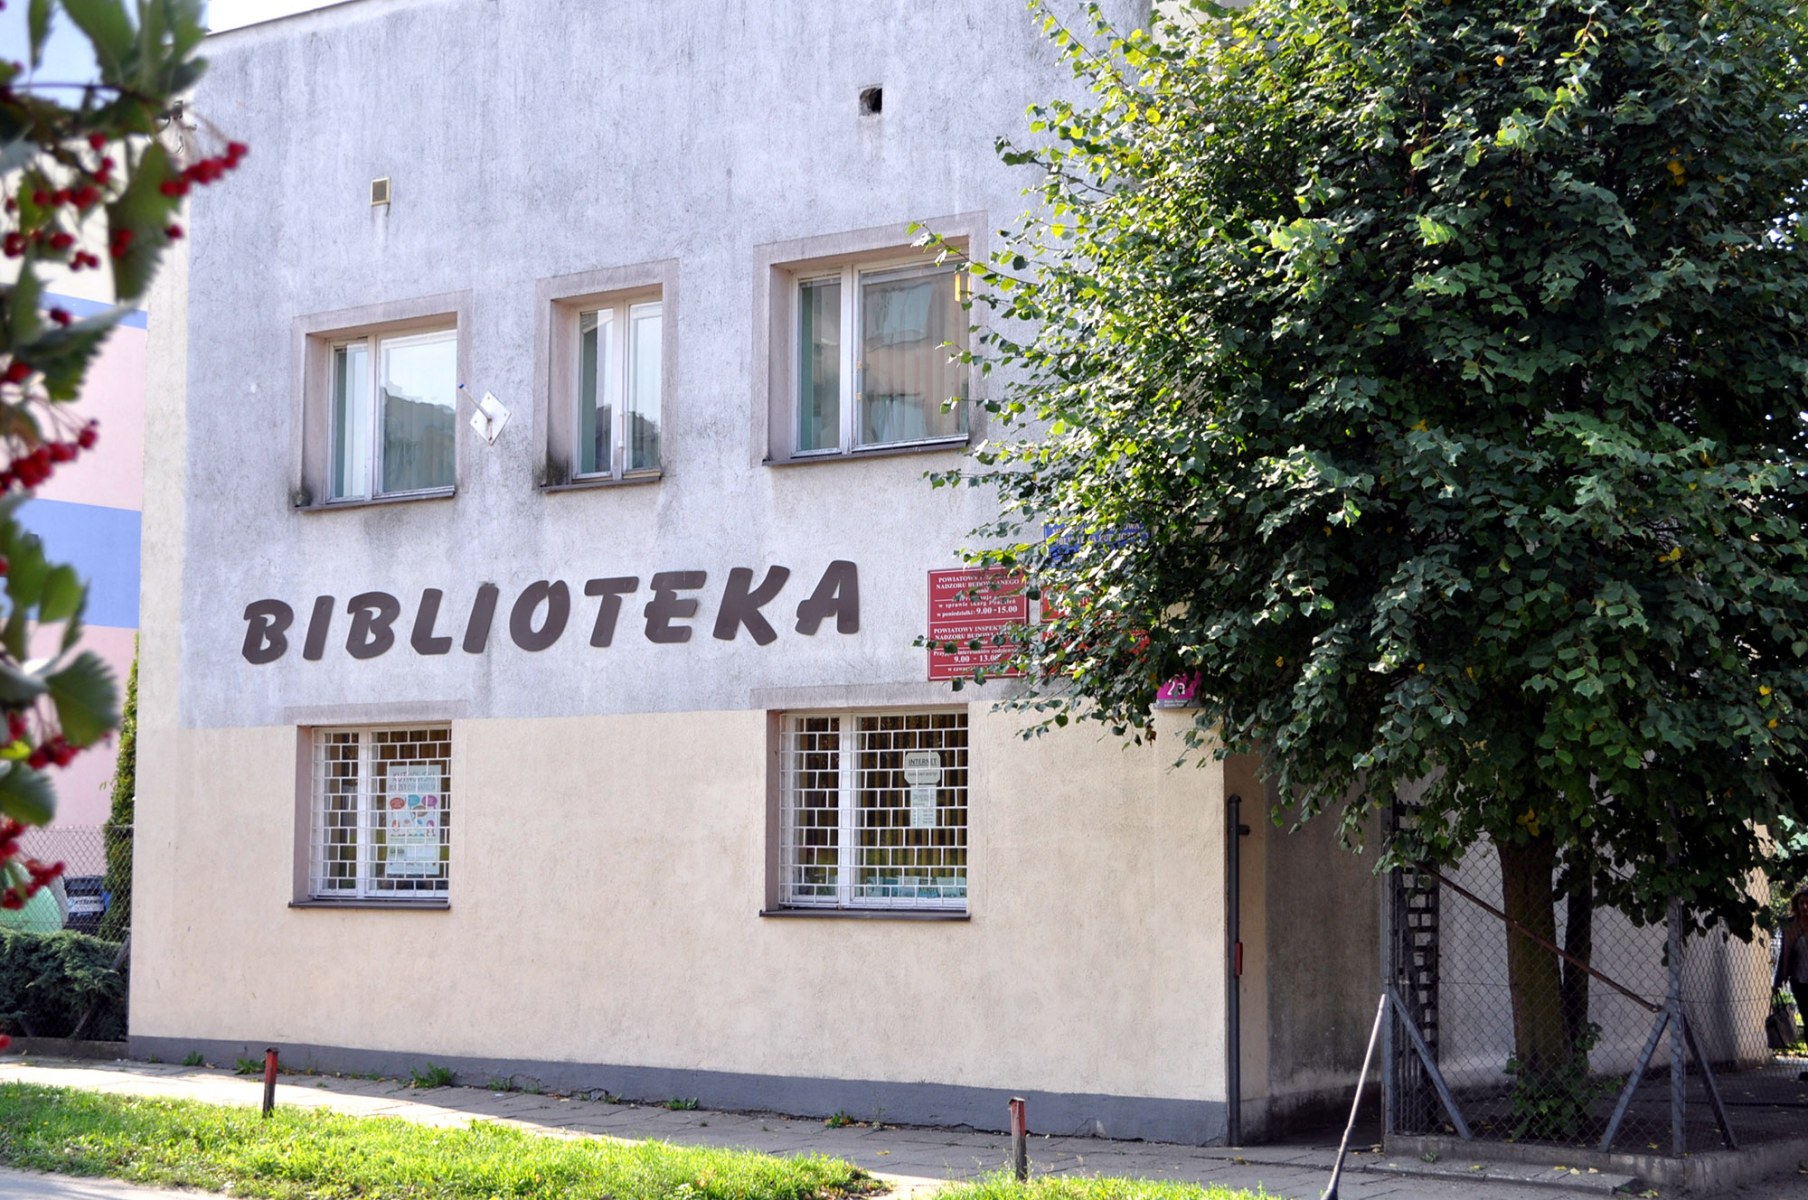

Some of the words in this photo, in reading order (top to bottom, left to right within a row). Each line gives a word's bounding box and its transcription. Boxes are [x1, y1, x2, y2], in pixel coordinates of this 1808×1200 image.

[241, 560, 860, 664] BIBLIOTEKA
[976, 607, 992, 615] 9.00
[934, 626, 973, 634] POWIATOWY
[954, 655, 970, 663] 9.00
